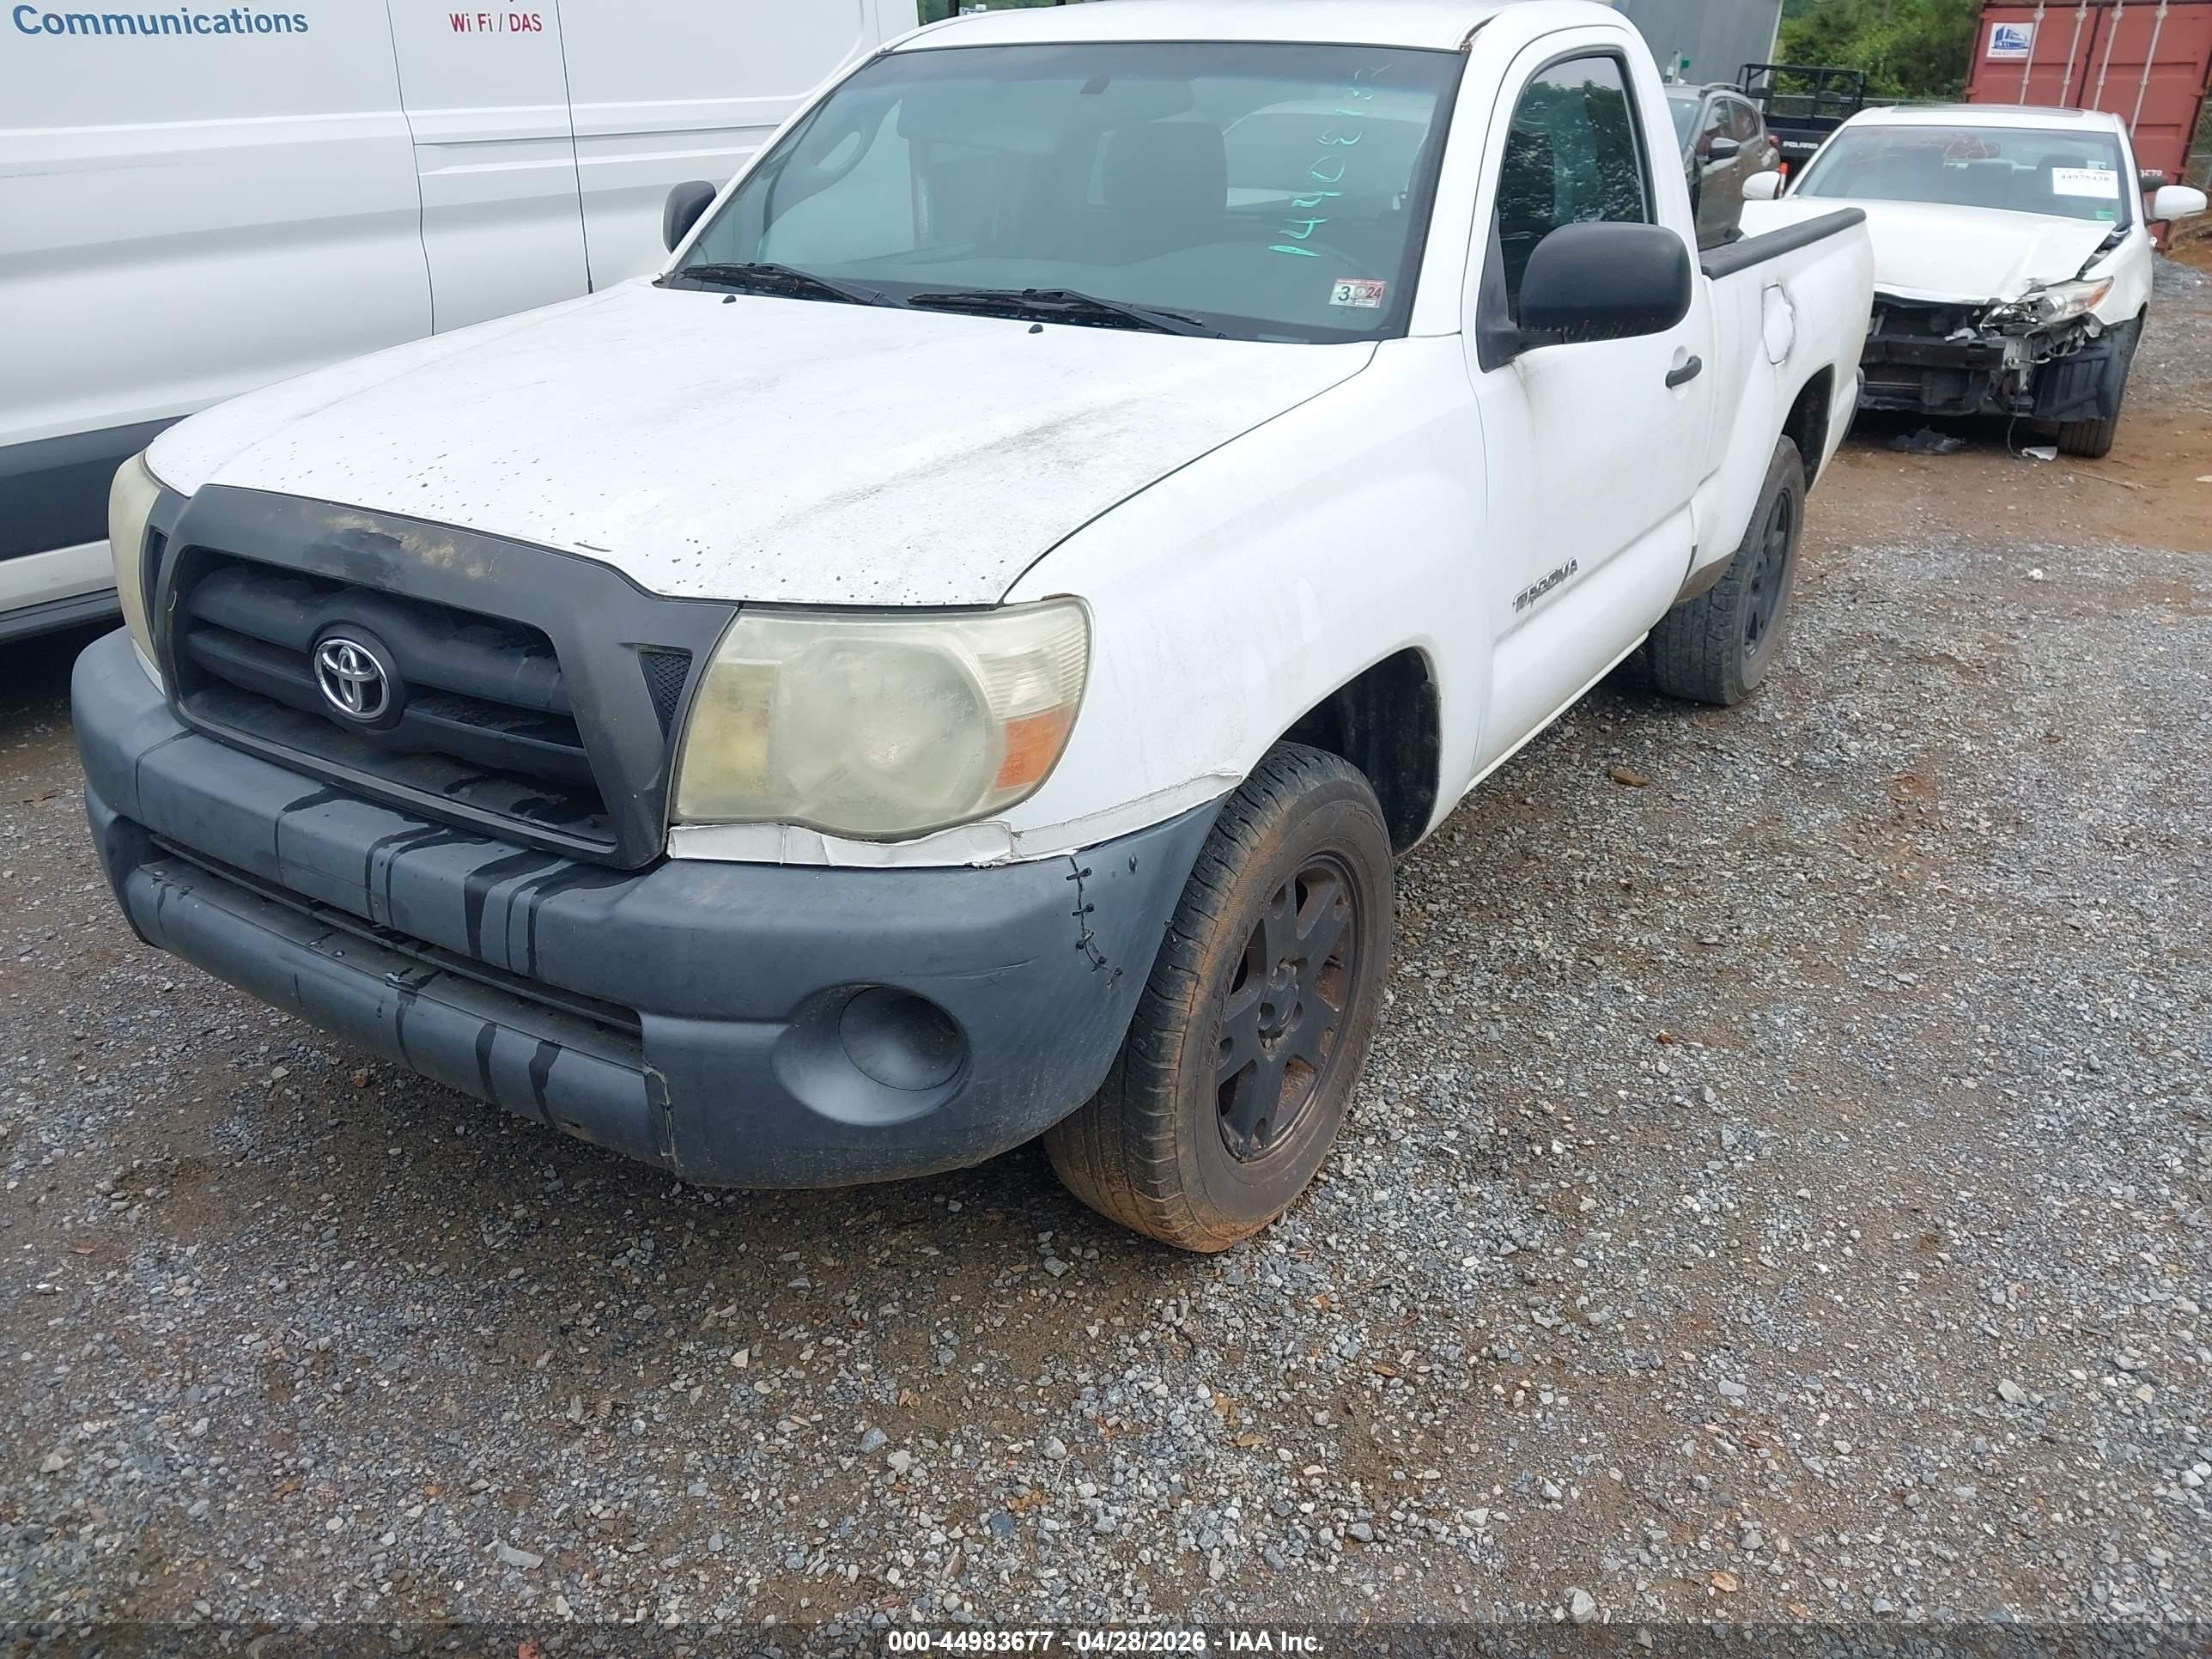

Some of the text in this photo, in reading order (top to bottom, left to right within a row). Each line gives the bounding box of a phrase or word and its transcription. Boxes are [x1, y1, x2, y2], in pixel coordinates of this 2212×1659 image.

[12, 4, 309, 35] Communications
[448, 12, 471, 33] Wi
[477, 12, 493, 33] Fi
[508, 12, 543, 33] DAS
[1338, 285, 1382, 301] 3 24
